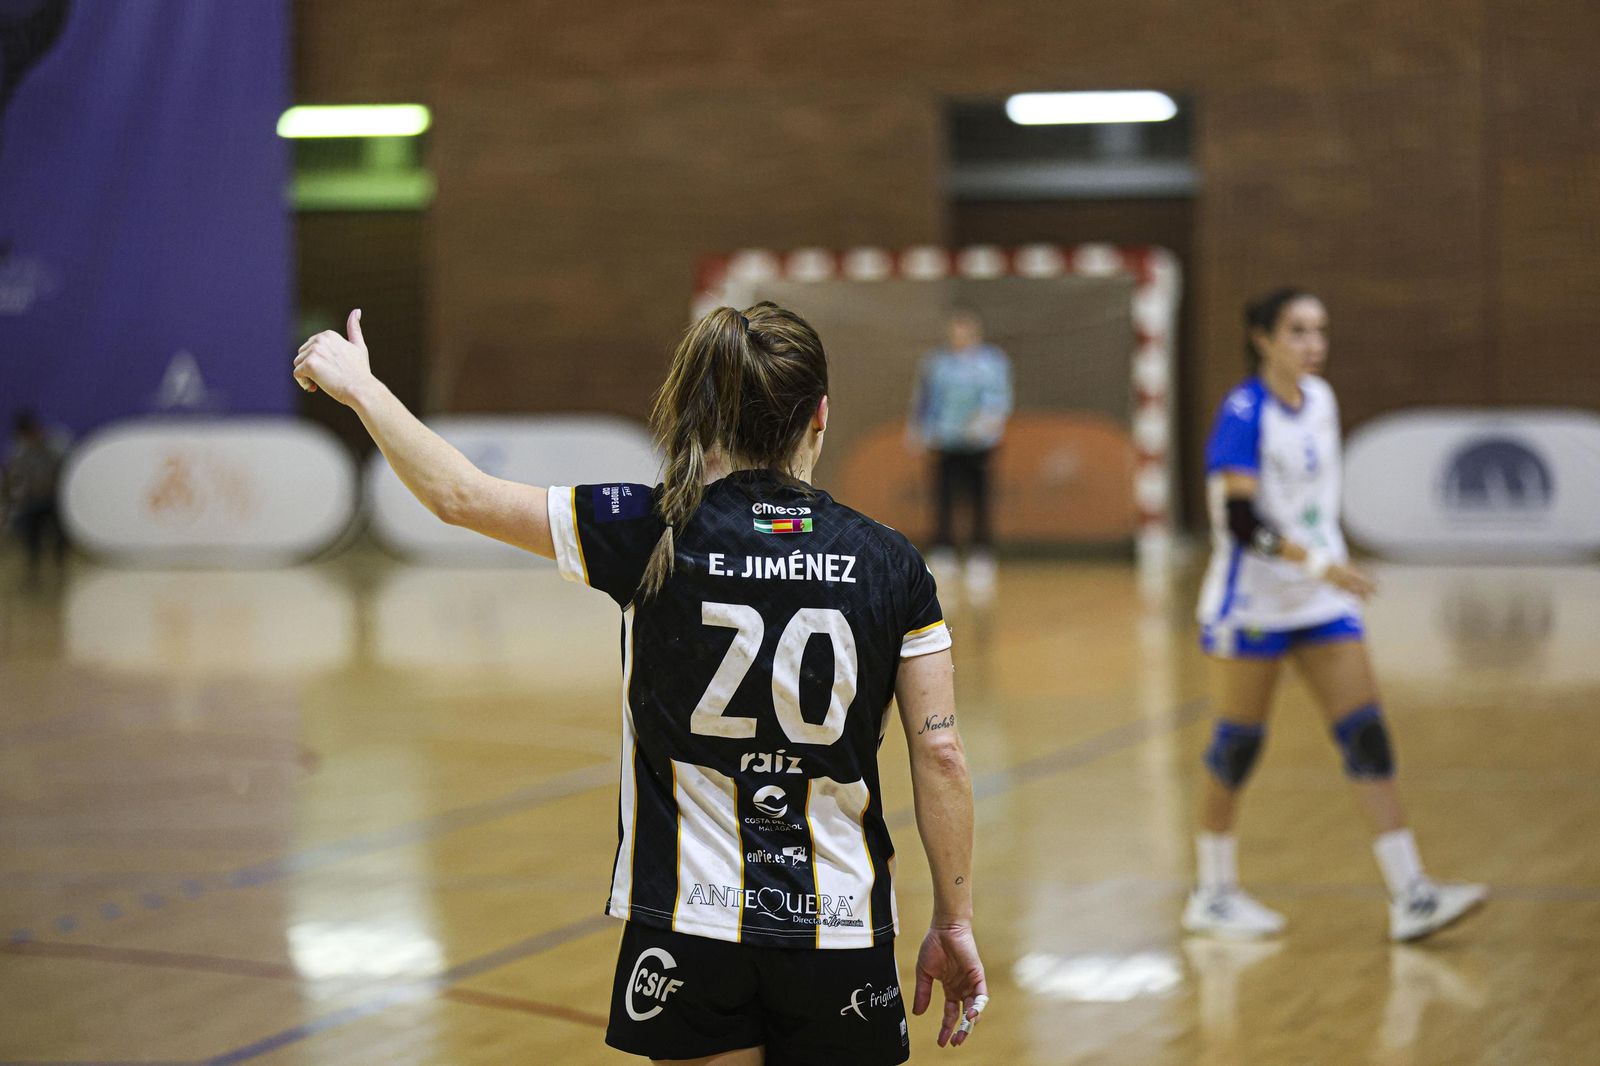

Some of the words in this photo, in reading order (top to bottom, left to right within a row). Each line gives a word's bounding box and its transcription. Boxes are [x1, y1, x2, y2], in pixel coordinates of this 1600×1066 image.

[708, 552, 734, 577] E.
[741, 550, 857, 583] JIMÉNEZ
[690, 601, 858, 745] 20
[740, 749, 803, 774] raíz
[792, 915, 821, 925] Directa
[634, 967, 685, 1002] CSIF
